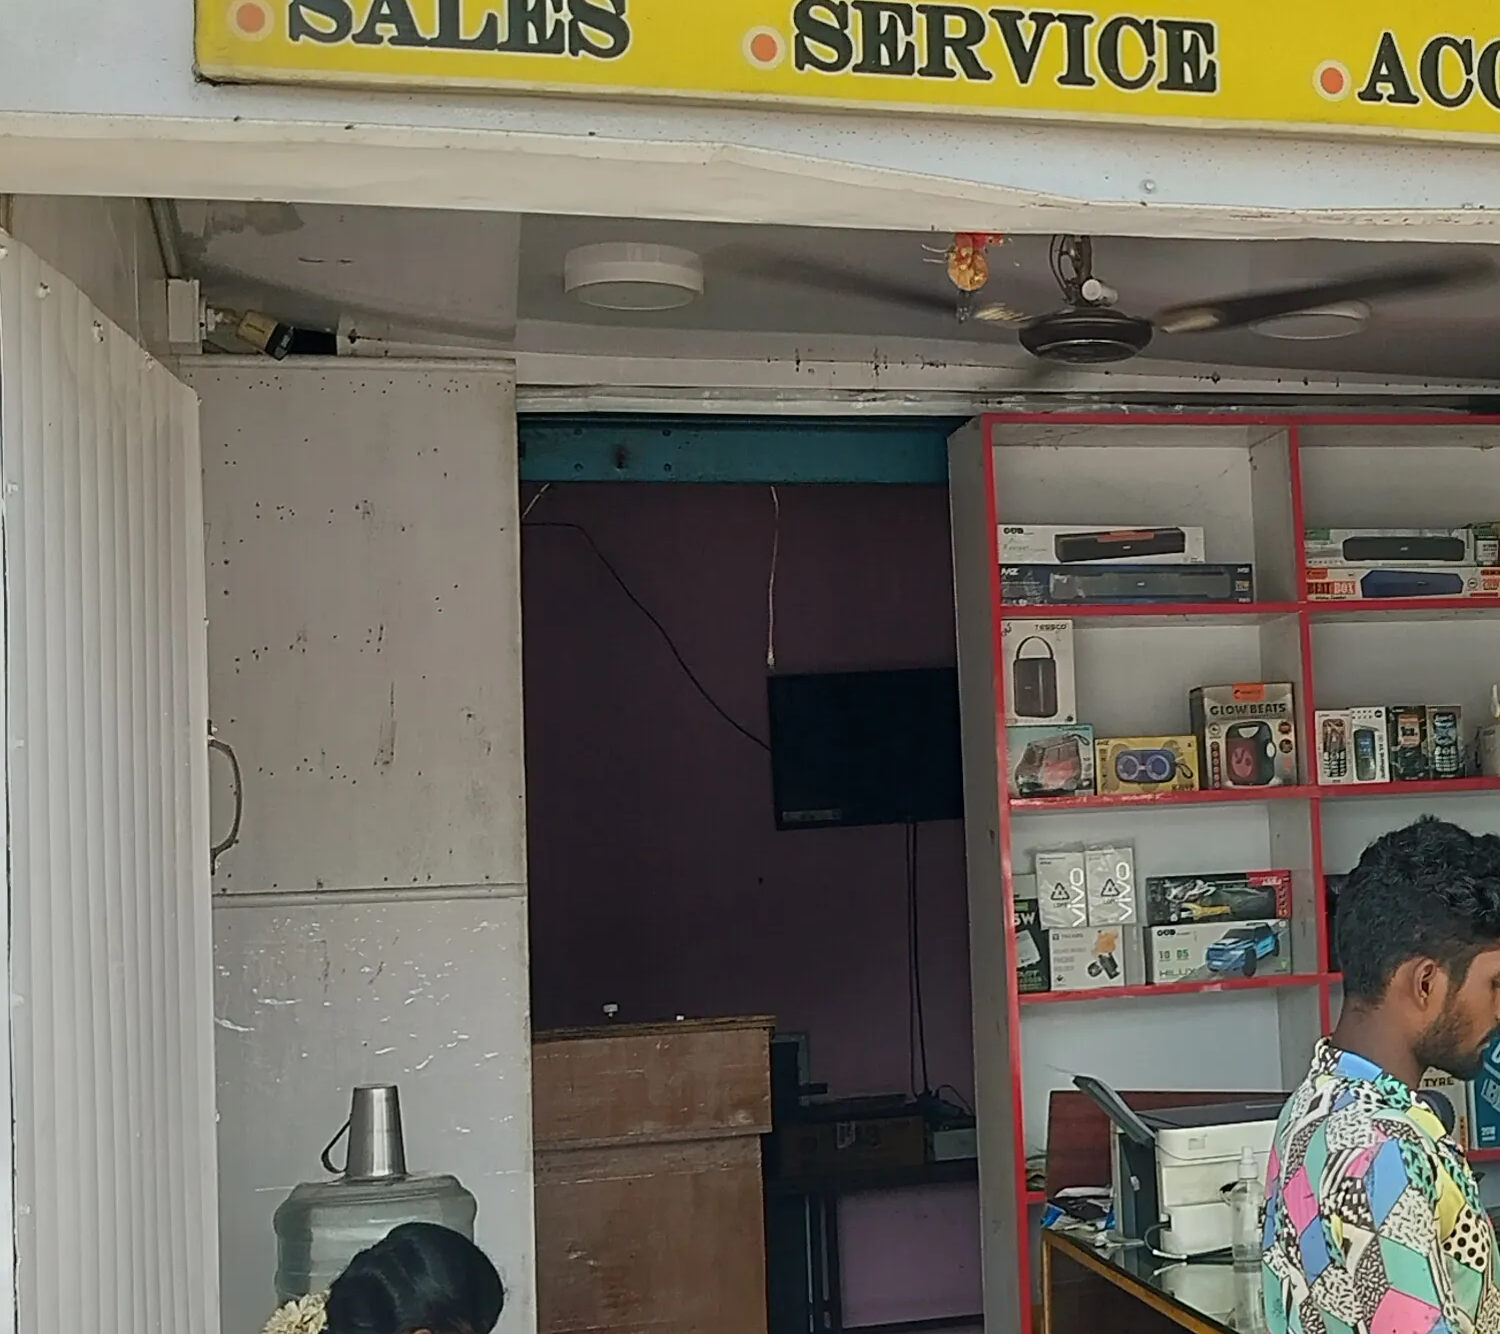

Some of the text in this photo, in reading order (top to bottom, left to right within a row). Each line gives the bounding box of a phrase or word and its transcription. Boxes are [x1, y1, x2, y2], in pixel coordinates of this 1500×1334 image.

[1249, 703, 1287, 714] BEATS
[1067, 867, 1086, 928] vivo
[1115, 861, 1133, 921] vivo
[1424, 1075, 1455, 1087] TYRE
